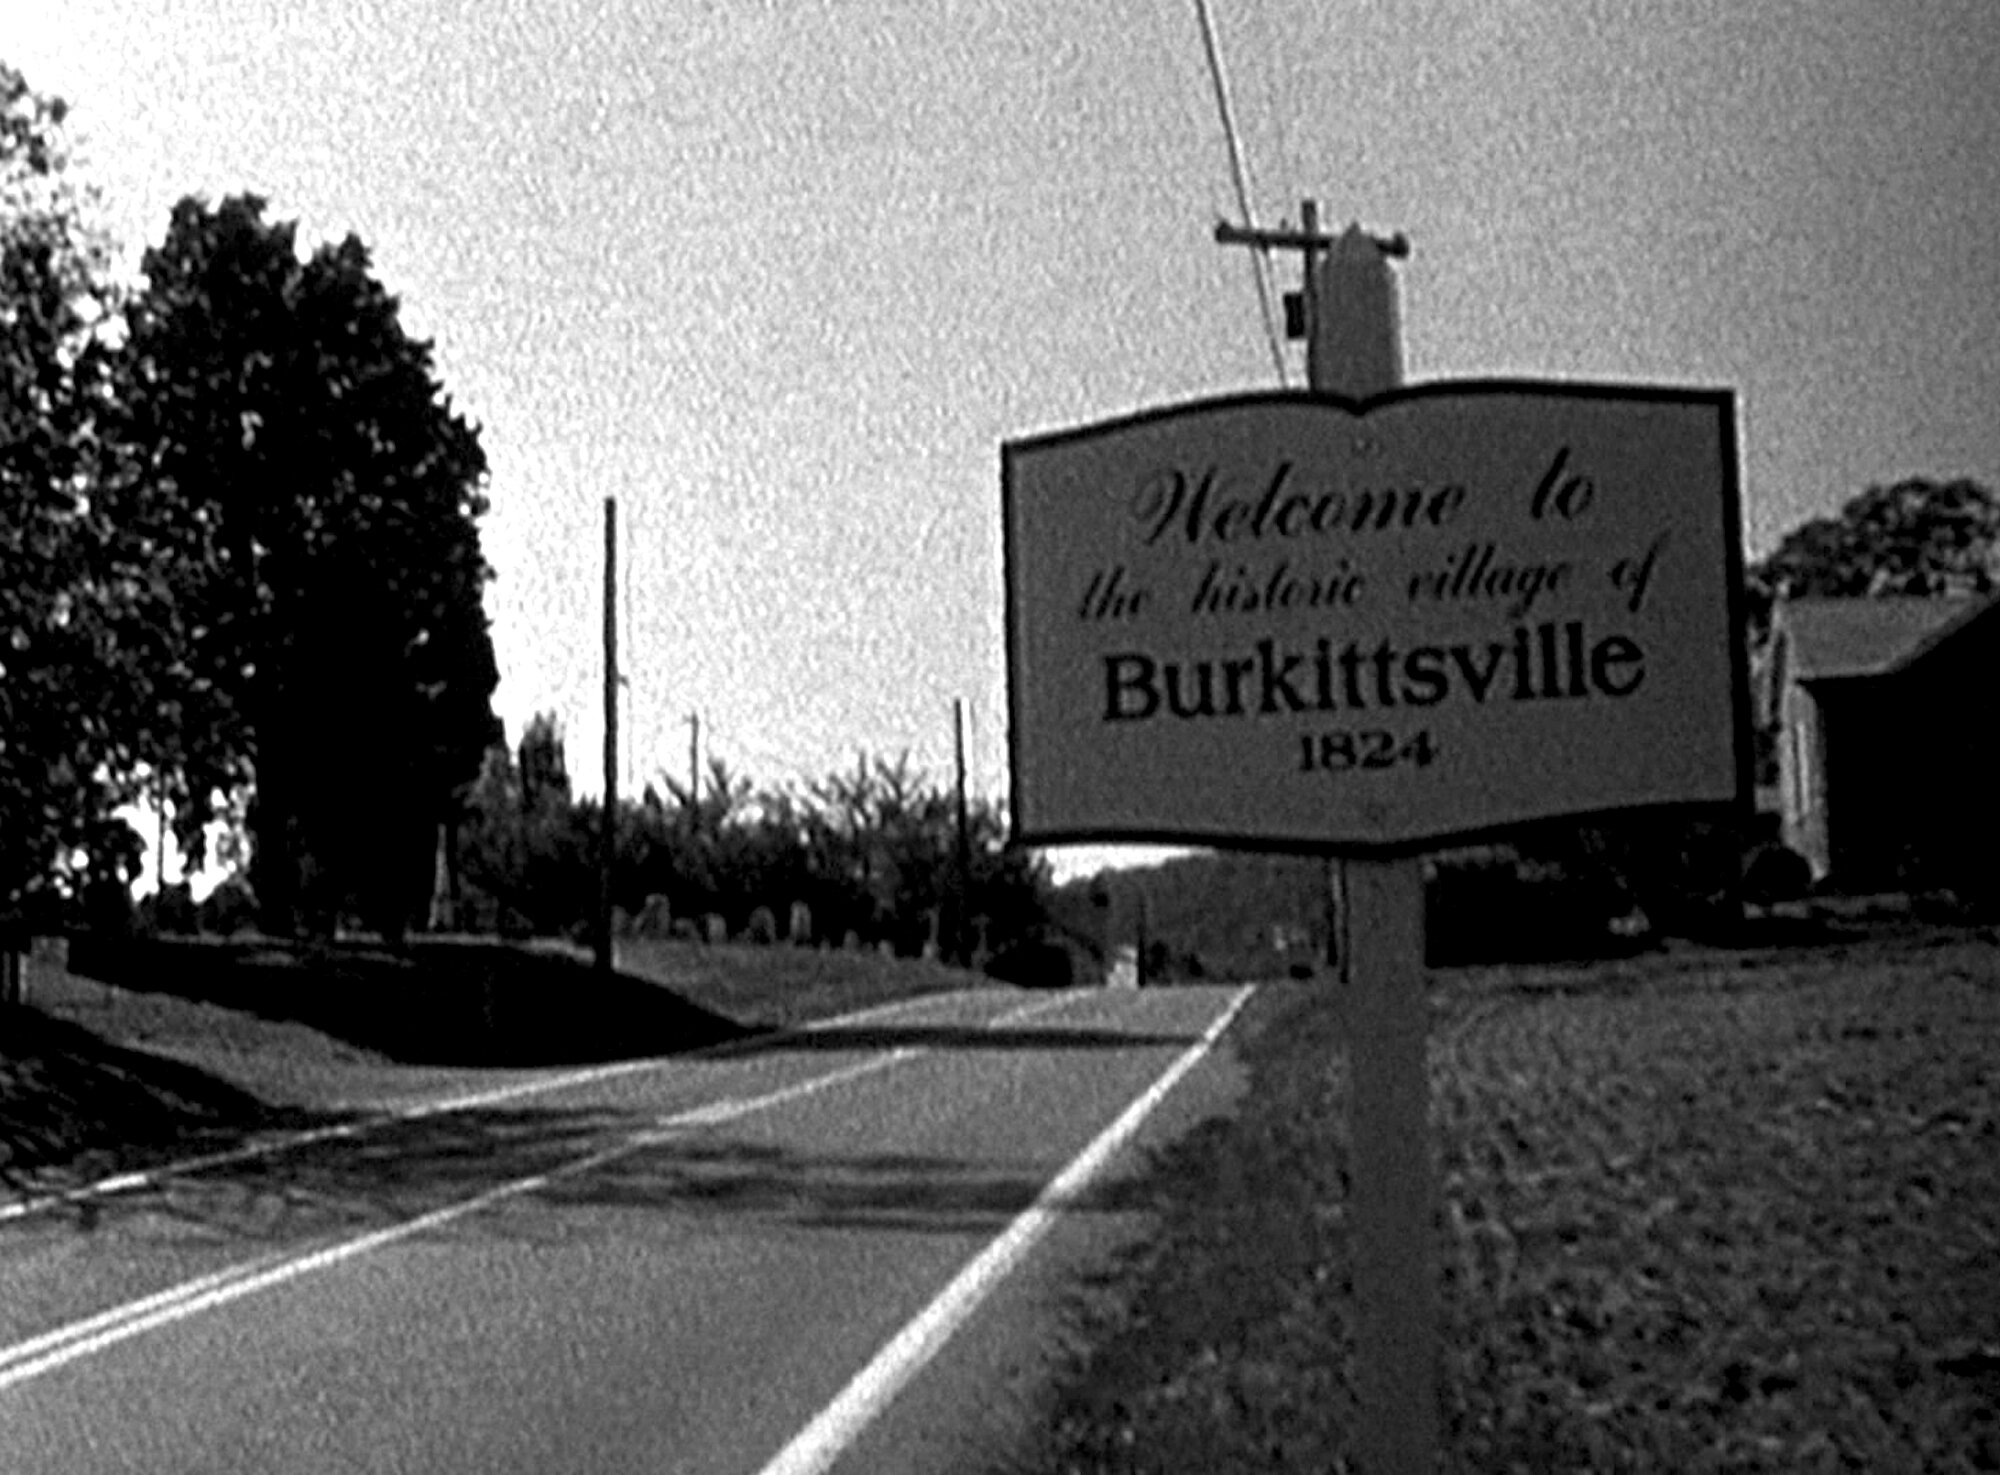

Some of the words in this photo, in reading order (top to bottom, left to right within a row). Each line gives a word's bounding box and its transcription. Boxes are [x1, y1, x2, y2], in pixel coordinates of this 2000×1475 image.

[1131, 459, 1467, 546] Welcome
[1528, 446, 1595, 522] to
[1079, 565, 1152, 623] the
[1188, 557, 1367, 617] historic
[1407, 543, 1573, 619] village
[1608, 528, 1672, 614] of
[1102, 621, 1646, 723] Burkittsville
[1298, 730, 1439, 772] 1824
